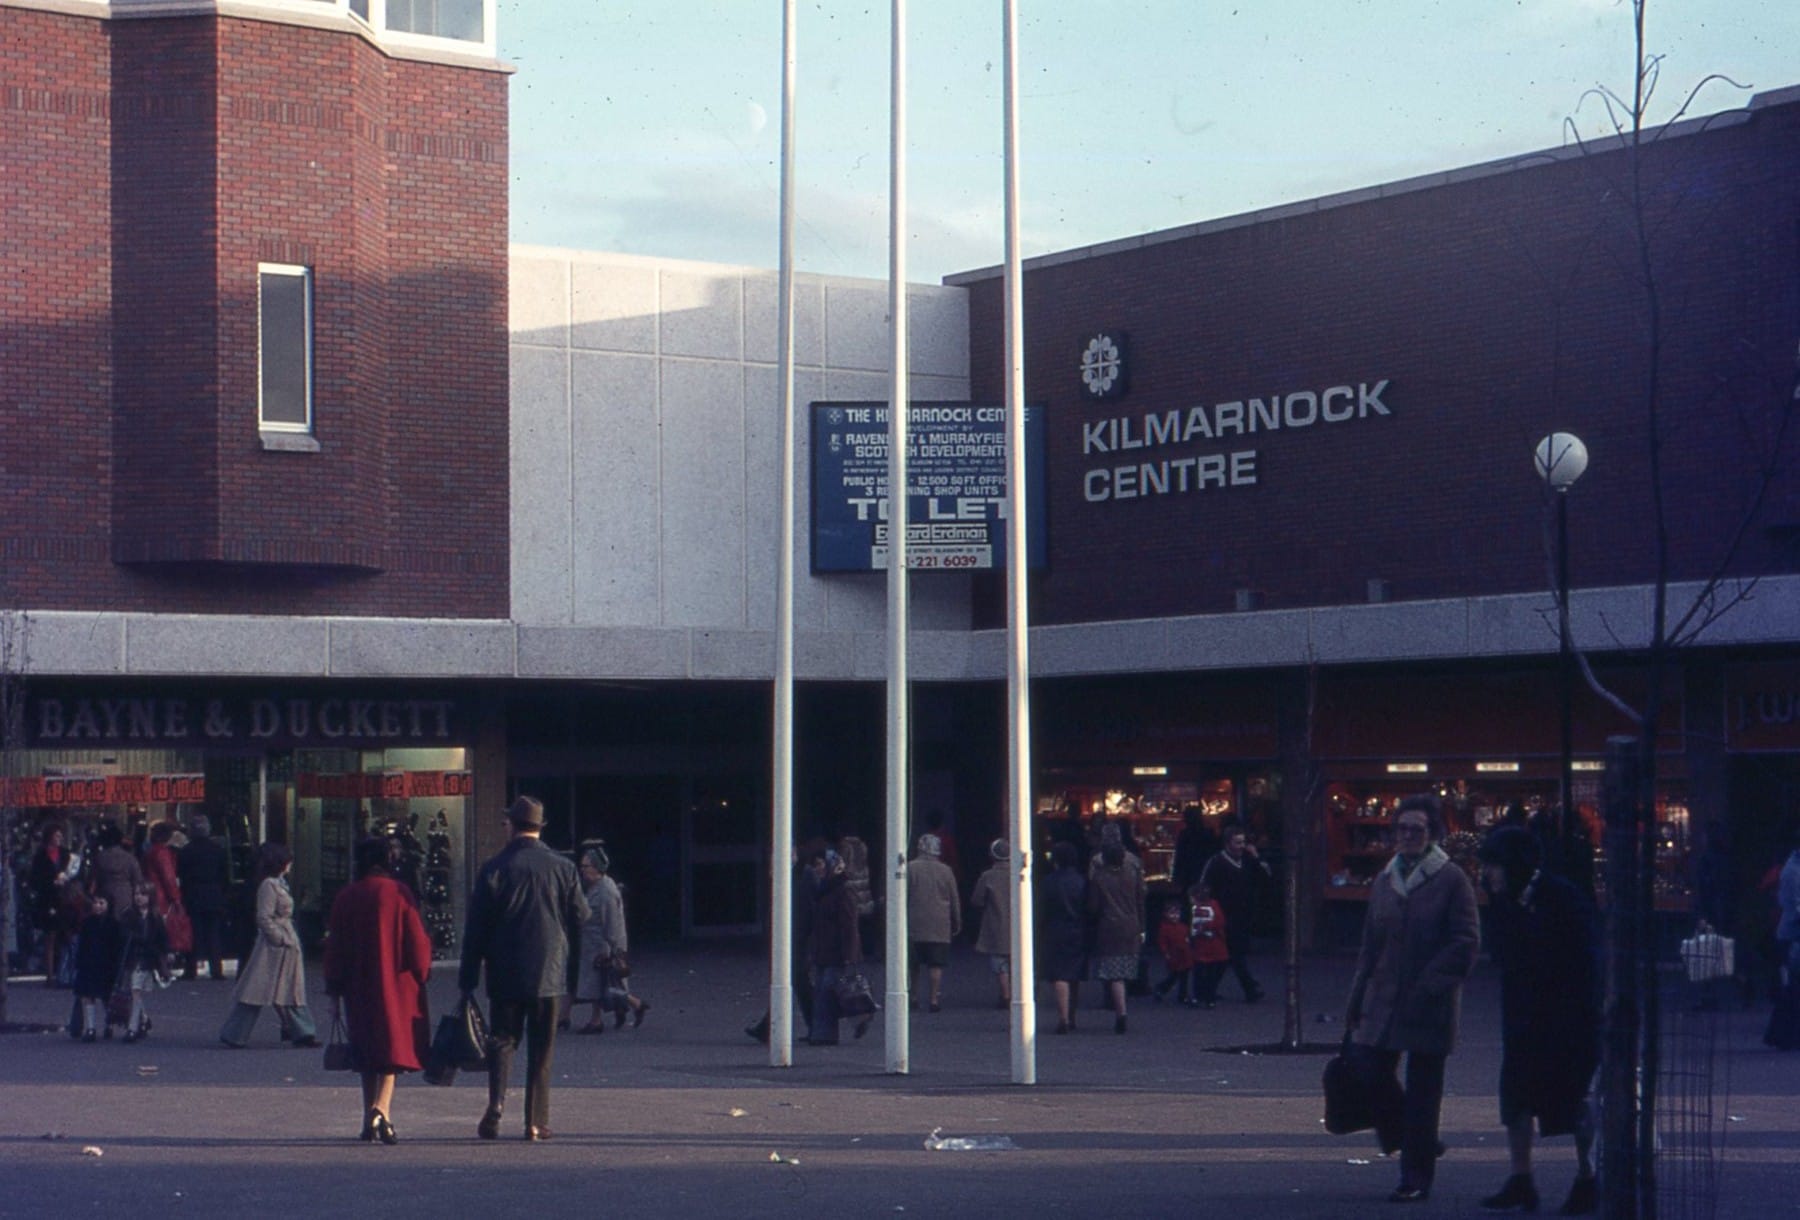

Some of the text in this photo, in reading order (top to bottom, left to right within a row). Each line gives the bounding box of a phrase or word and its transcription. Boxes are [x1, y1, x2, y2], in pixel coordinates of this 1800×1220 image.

[845, 408, 1029, 423] THE KIARNOCK CENE
[1083, 380, 1391, 454] KILMARNOCK
[918, 434, 927, 443] &
[929, 433, 1006, 444] MURRAYFIE
[843, 476, 875, 487] PUBLIC
[1084, 450, 1257, 502] CENTRE
[865, 487, 873, 496] 3
[934, 487, 962, 496] SHOP
[964, 486, 998, 496] UNITS
[928, 498, 1008, 520] LET
[931, 525, 987, 541] Erdman
[943, 555, 977, 567] 6039
[39, 699, 455, 738] BAYNE & DUCKETT
